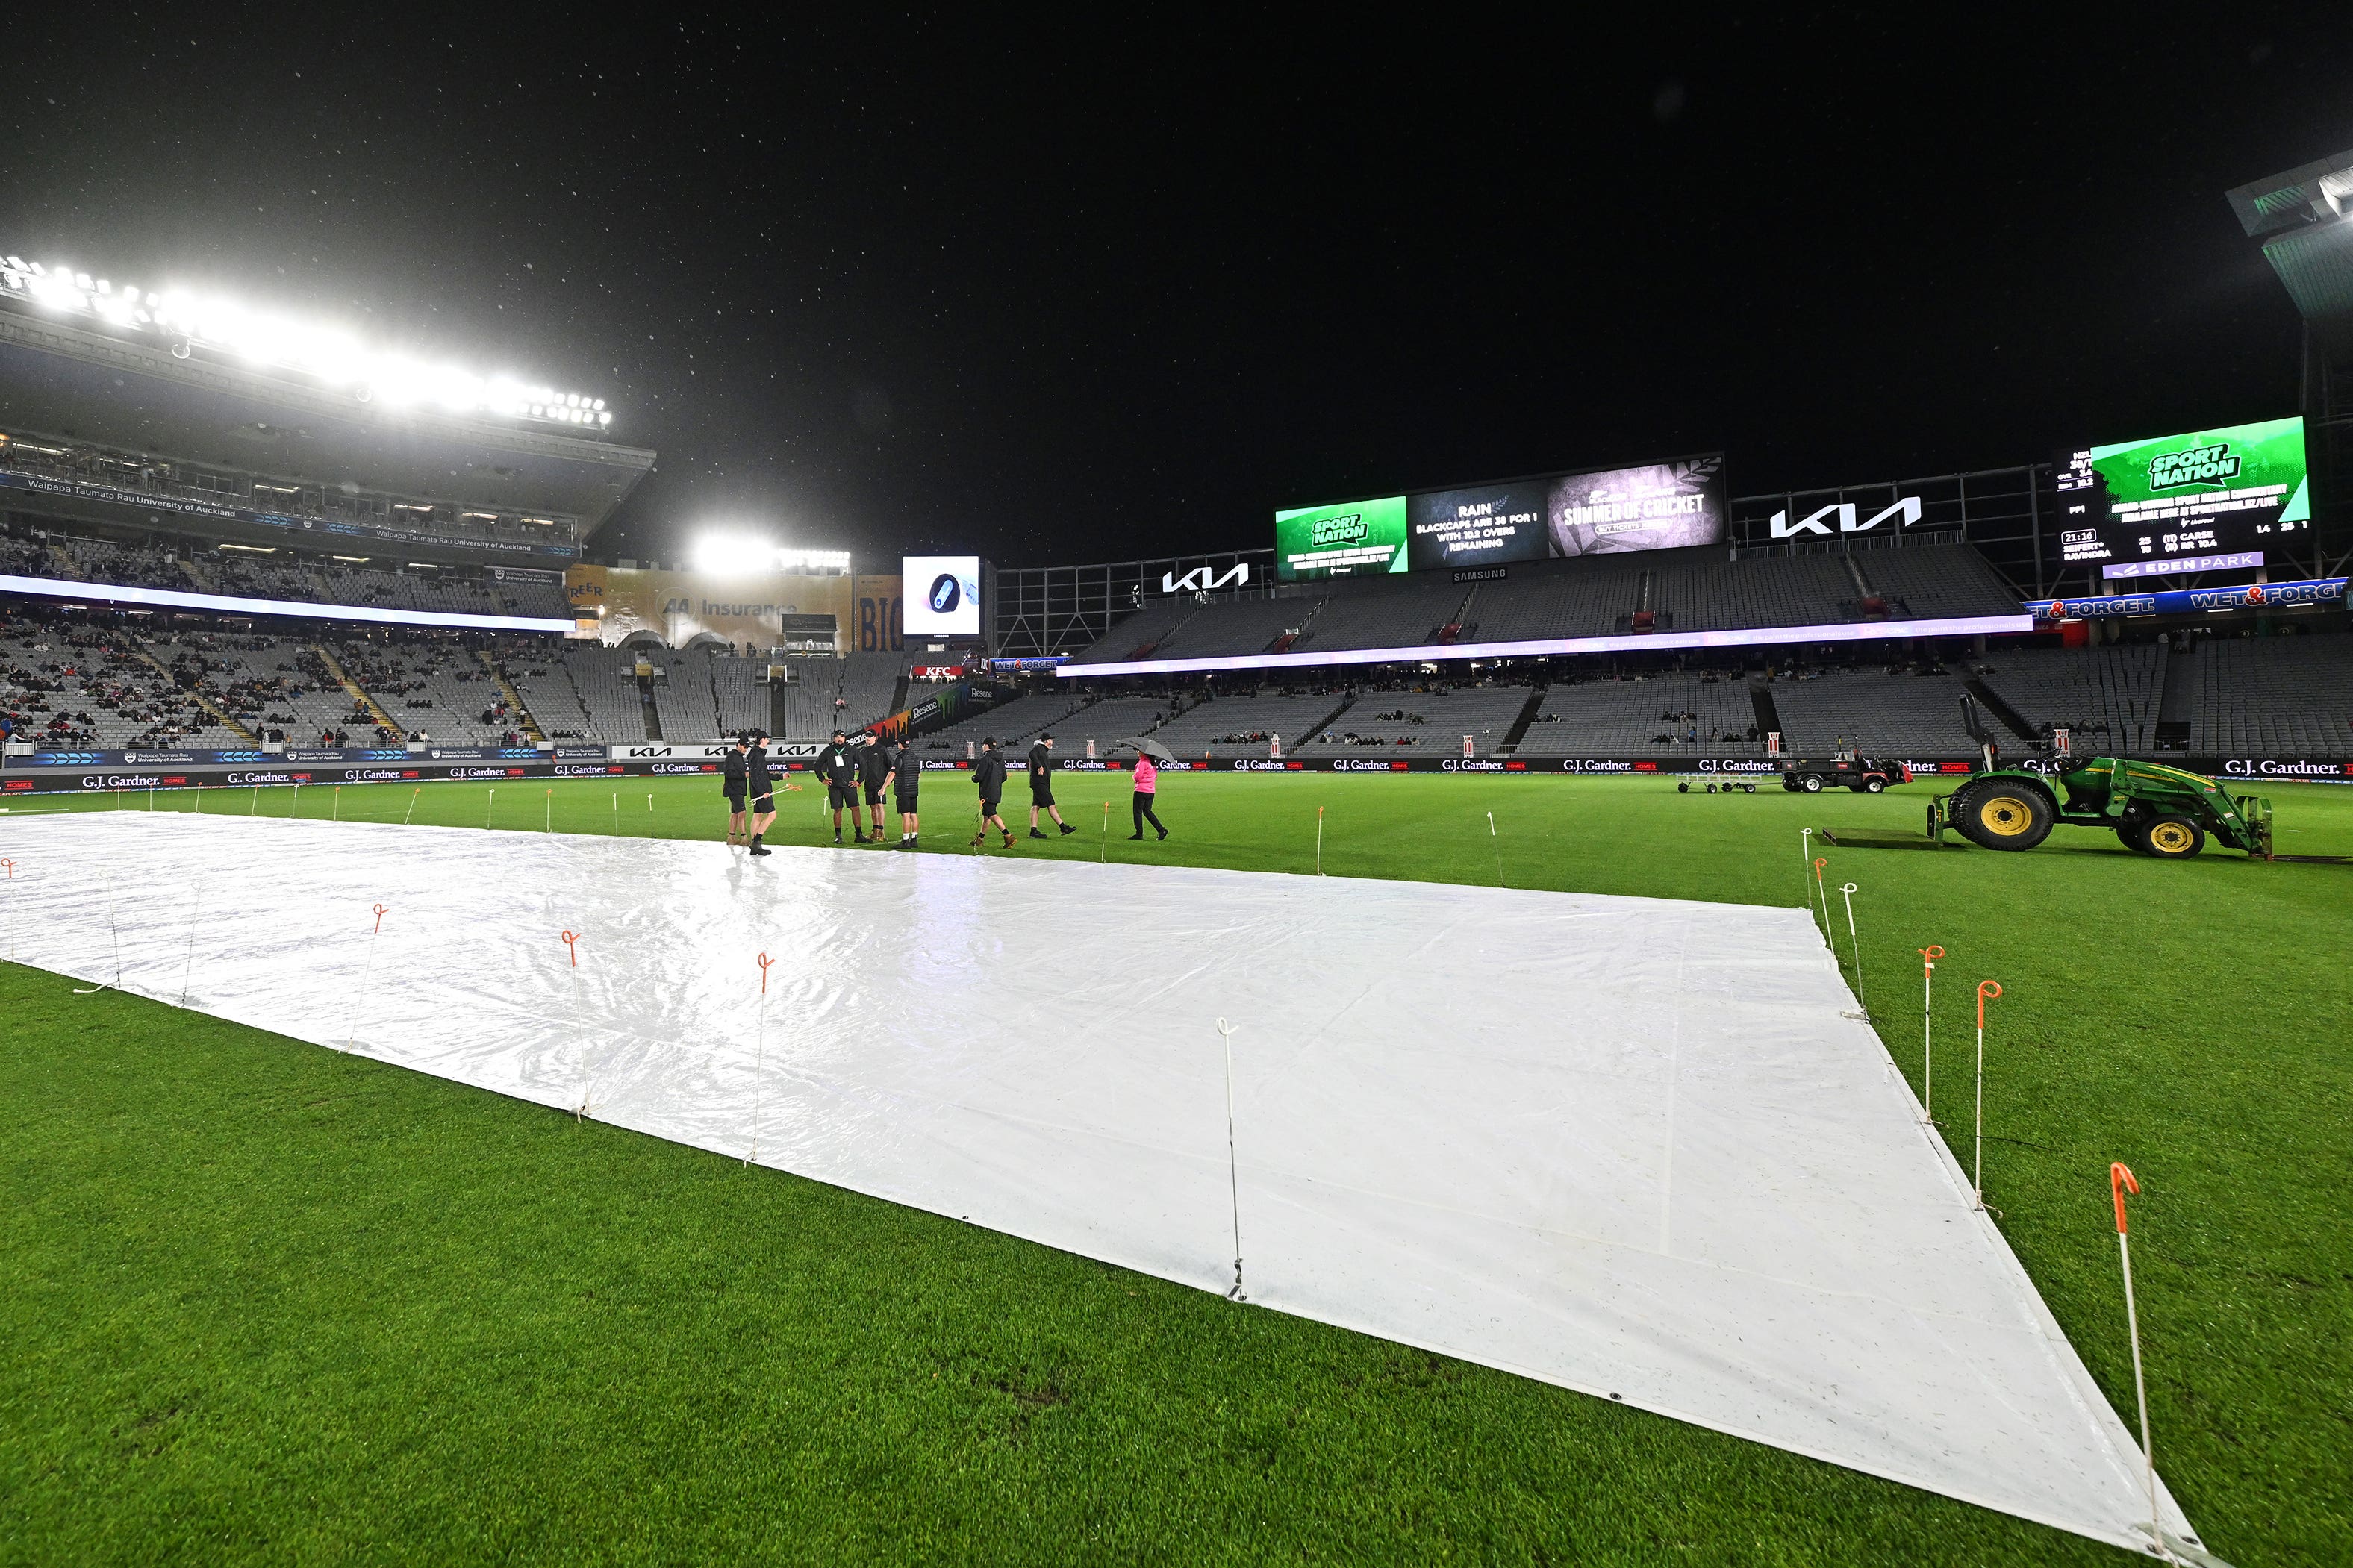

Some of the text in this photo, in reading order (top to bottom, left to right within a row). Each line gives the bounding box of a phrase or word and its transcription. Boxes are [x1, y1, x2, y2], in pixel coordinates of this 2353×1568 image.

[2073, 451, 2091, 460] NZL
[2152, 446, 2224, 472] SPORT
[2153, 458, 2235, 487] NATION
[28, 480, 72, 493] Waipapa
[75, 487, 115, 499] Taumata
[117, 493, 135, 502] Rau
[137, 496, 183, 510] University
[196, 506, 236, 517] Auckland
[1458, 503, 1492, 518] RAIN
[1564, 503, 1621, 526] SUMMER
[1624, 502, 1641, 520] OF
[1643, 493, 1704, 518] CRICKET
[1314, 515, 1359, 533] SPORT
[1416, 520, 1471, 534] BLACKCAPS
[1473, 517, 1492, 528] ARE
[1509, 514, 1530, 525] FOR
[1532, 512, 1538, 522] 1
[1314, 525, 1365, 544] NATION
[1437, 526, 1515, 543] WITH 10.2 OVERS
[2179, 530, 2214, 541] CARSE
[2301, 520, 2307, 529] 1
[376, 531, 407, 540] Waipapa
[409, 533, 438, 543] Taumata
[454, 538, 489, 548] University
[499, 543, 531, 552] Auckland
[2065, 532, 2093, 542] 21:16
[1449, 538, 1503, 552] REMAINING
[2180, 538, 2218, 550] RR 10.4
[2063, 549, 2112, 561] RAVINDRA
[2140, 545, 2152, 554] 10
[2145, 555, 2253, 574] EDEN PARK
[1454, 569, 1506, 581] SAMSUNG
[662, 598, 689, 614] AA
[2028, 597, 2155, 619] ET&FORGET
[1963, 622, 2015, 631] professionals
[925, 667, 950, 675] KFC
[994, 660, 1058, 670] WET&FORGET
[971, 688, 993, 698] Resene
[912, 701, 937, 719] Resene
[846, 733, 867, 746] esene
[555, 766, 570, 775] G.J.
[571, 765, 606, 774] Gardner.
[652, 763, 667, 773] G.J.
[667, 763, 700, 772] Gardner.
[767, 763, 788, 771] rdner.
[926, 760, 955, 769] Gardner.
[1063, 760, 1076, 770] G.J.
[1076, 760, 1106, 768] Gardner.
[1235, 760, 1250, 771] G.J.
[1250, 760, 1285, 769] Gardner.
[1333, 760, 1350, 771] G.J.
[1350, 760, 1389, 769] Gardner.
[1442, 760, 1460, 772] G.J.
[1461, 760, 1504, 770] Gardner.
[1563, 760, 1583, 772] G.J.
[1584, 760, 1632, 771] Gardner.
[1698, 760, 1775, 773] G.J. Gardner.
[1906, 760, 1937, 772] dner.
[2225, 760, 2340, 776] G.J. Gardner.
[245, 772, 289, 783] Gardner.
[345, 769, 361, 781] G.J.
[363, 769, 401, 780] Gardner.
[450, 768, 467, 778] G.J.
[468, 767, 505, 776] Gardner.
[82, 776, 105, 789] G.J.
[108, 775, 160, 787] Gardner.
